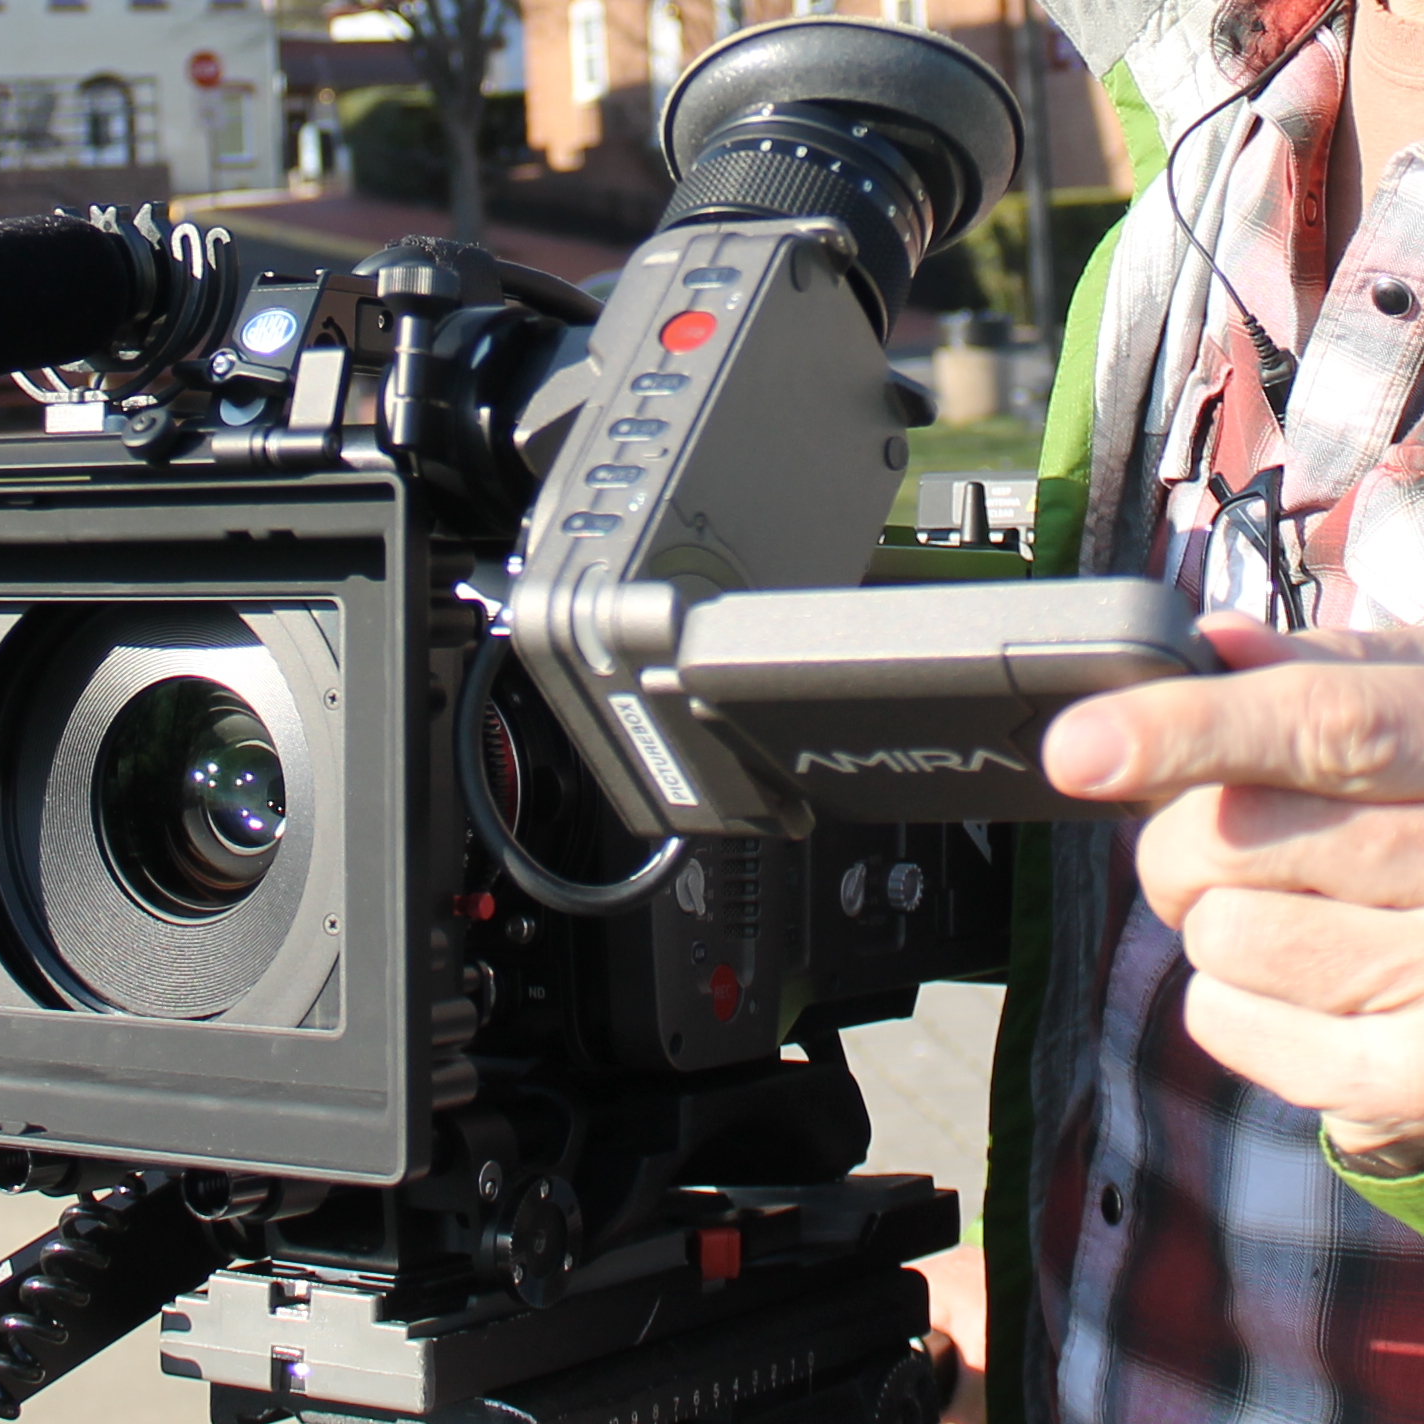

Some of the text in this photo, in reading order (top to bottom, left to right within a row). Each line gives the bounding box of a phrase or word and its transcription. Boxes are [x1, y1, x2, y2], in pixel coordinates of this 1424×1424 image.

[614, 699, 691, 802] PICTUREBOX
[794, 748, 1027, 774] AMIRA
[528, 986, 546, 1000] ND
[714, 984, 734, 1000] REC
[652, 1403, 660, 1418] 8
[672, 1396, 680, 1412] 7
[693, 1390, 700, 1405] 6
[712, 1383, 720, 1398] 5
[732, 1377, 740, 1391] 4
[751, 1369, 759, 1383] 3
[770, 1363, 778, 1378] 2
